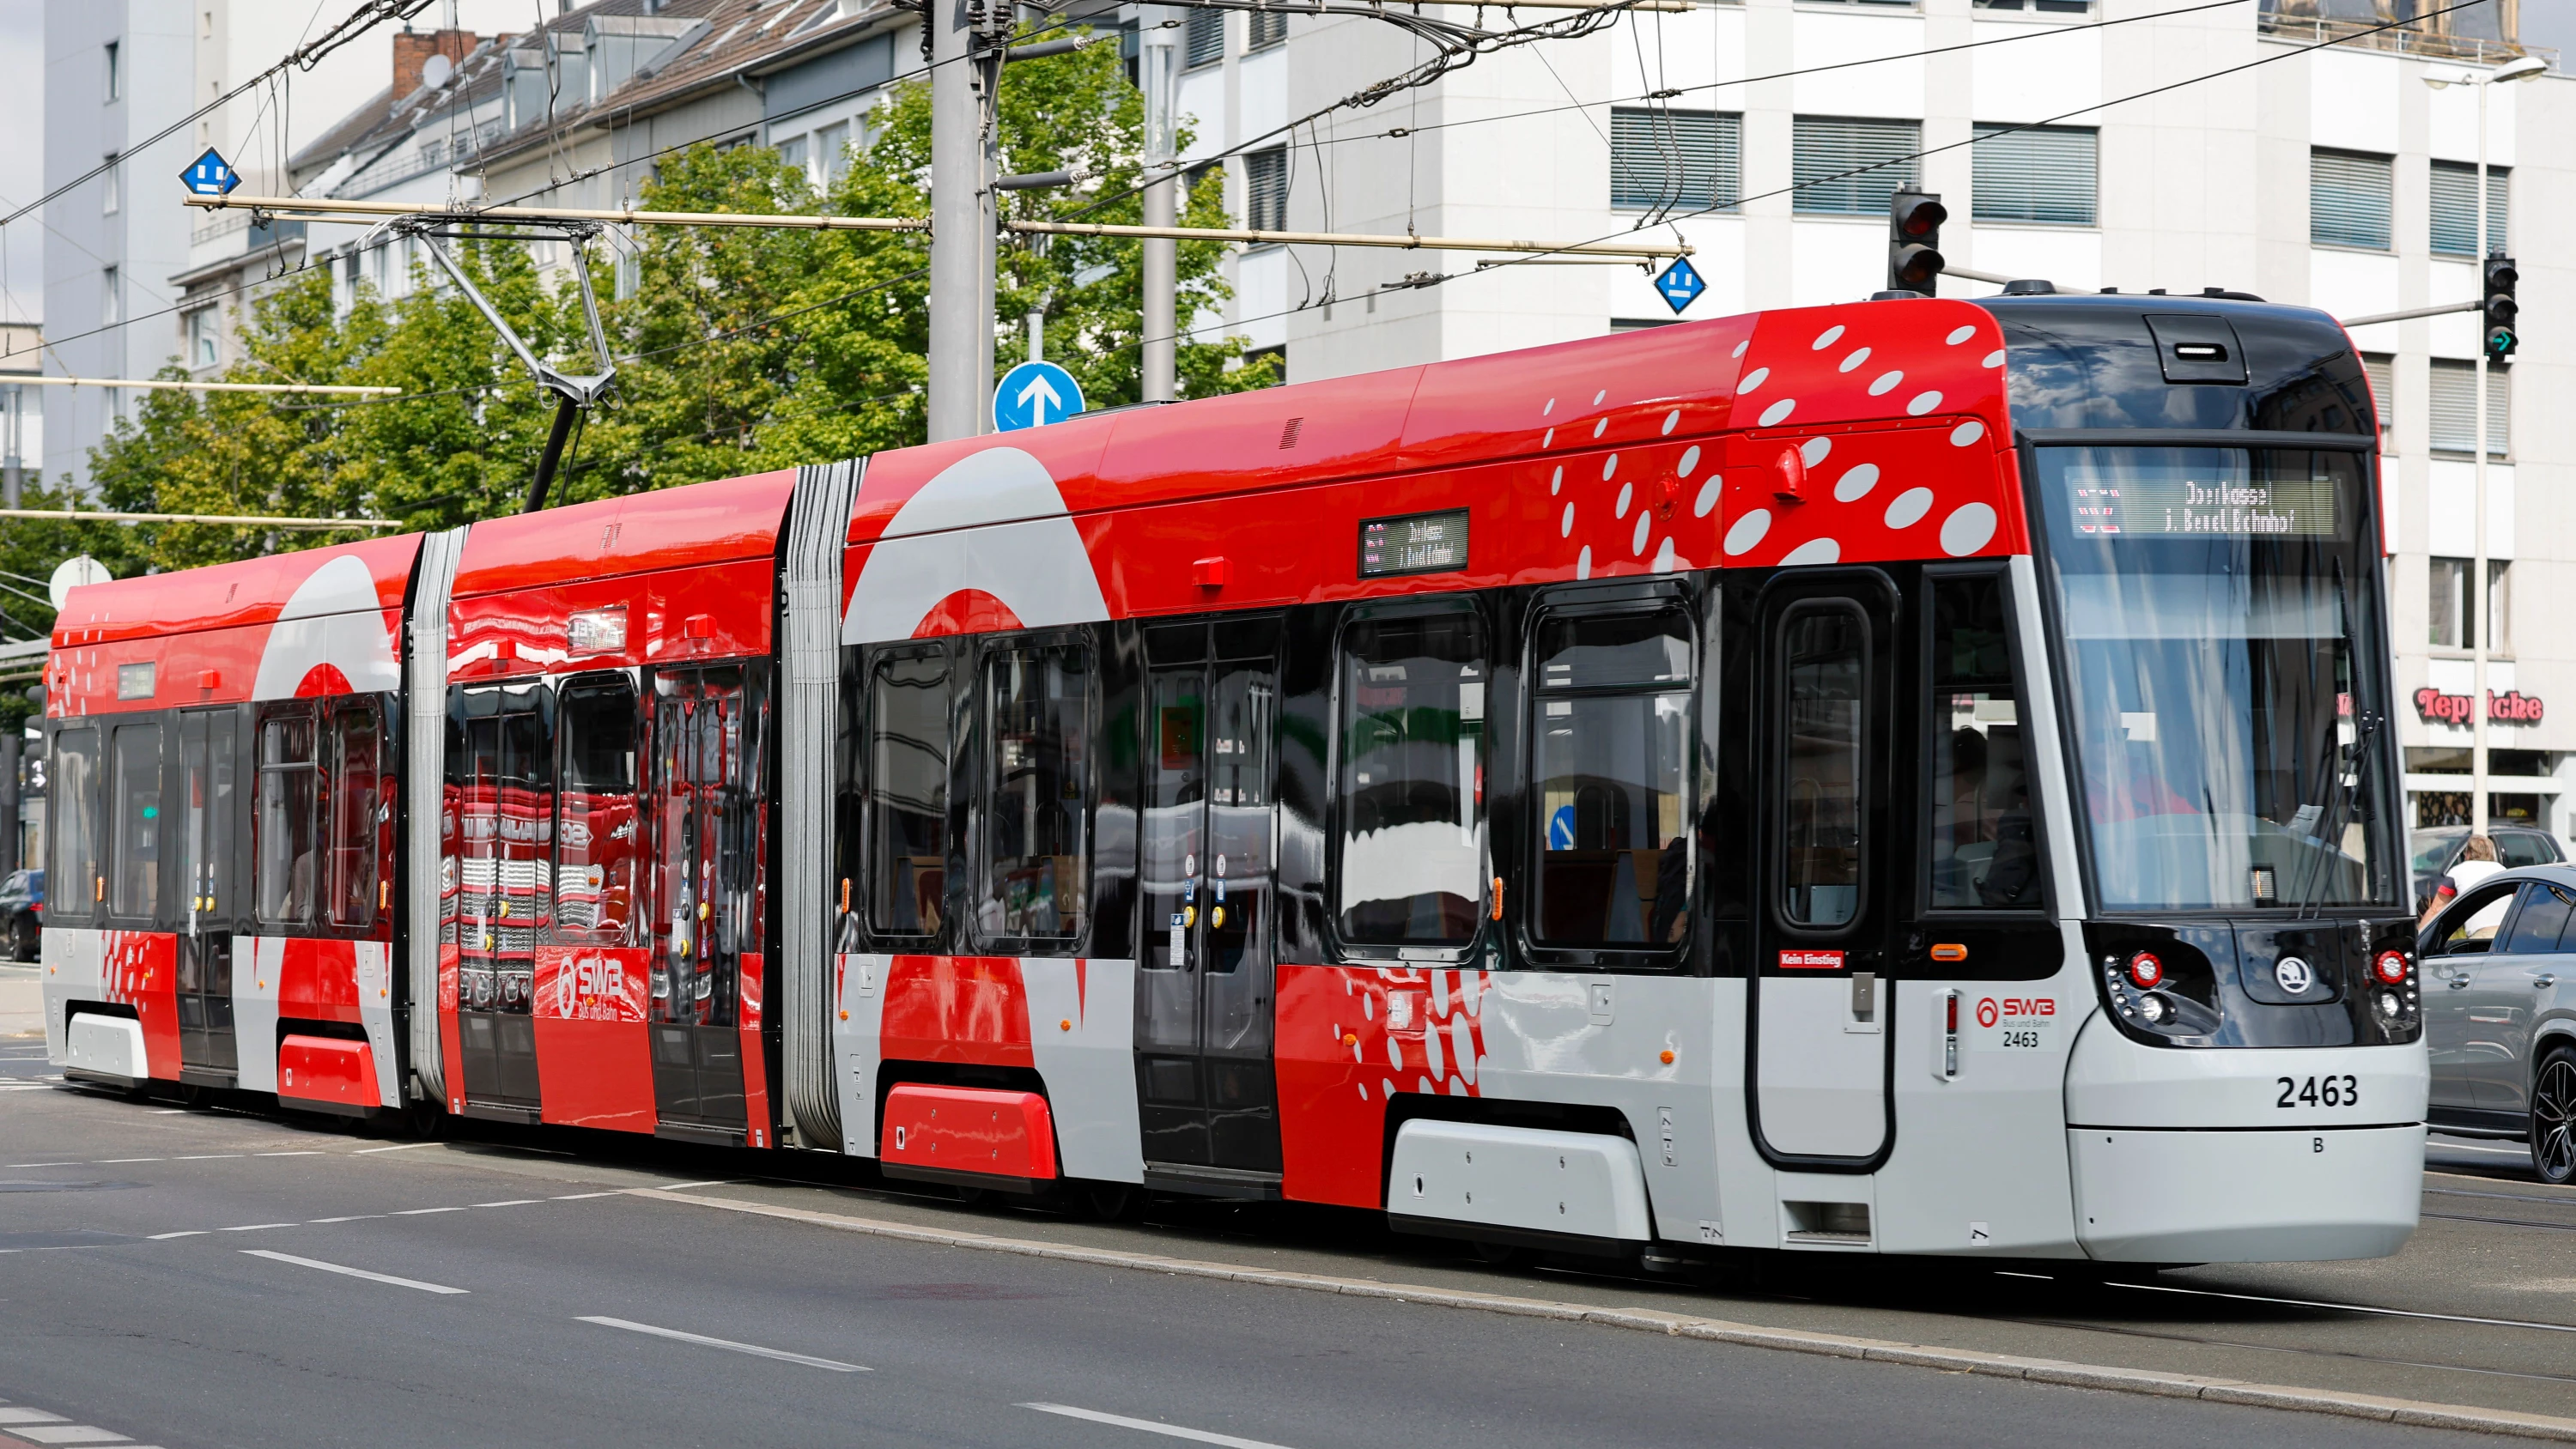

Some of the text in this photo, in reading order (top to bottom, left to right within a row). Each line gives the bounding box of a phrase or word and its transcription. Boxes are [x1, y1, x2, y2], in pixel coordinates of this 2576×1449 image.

[1781, 953, 1842, 968] Kein Einstieg
[579, 959, 623, 996] SWB
[603, 1003, 617, 1022] Bahn
[2002, 998, 2056, 1016] SWB
[2002, 1019, 2050, 1028] Bus und Bahn
[2002, 1031, 2038, 1048] 2463
[2276, 1074, 2359, 1108] 2463
[2312, 1137, 2324, 1154] B
